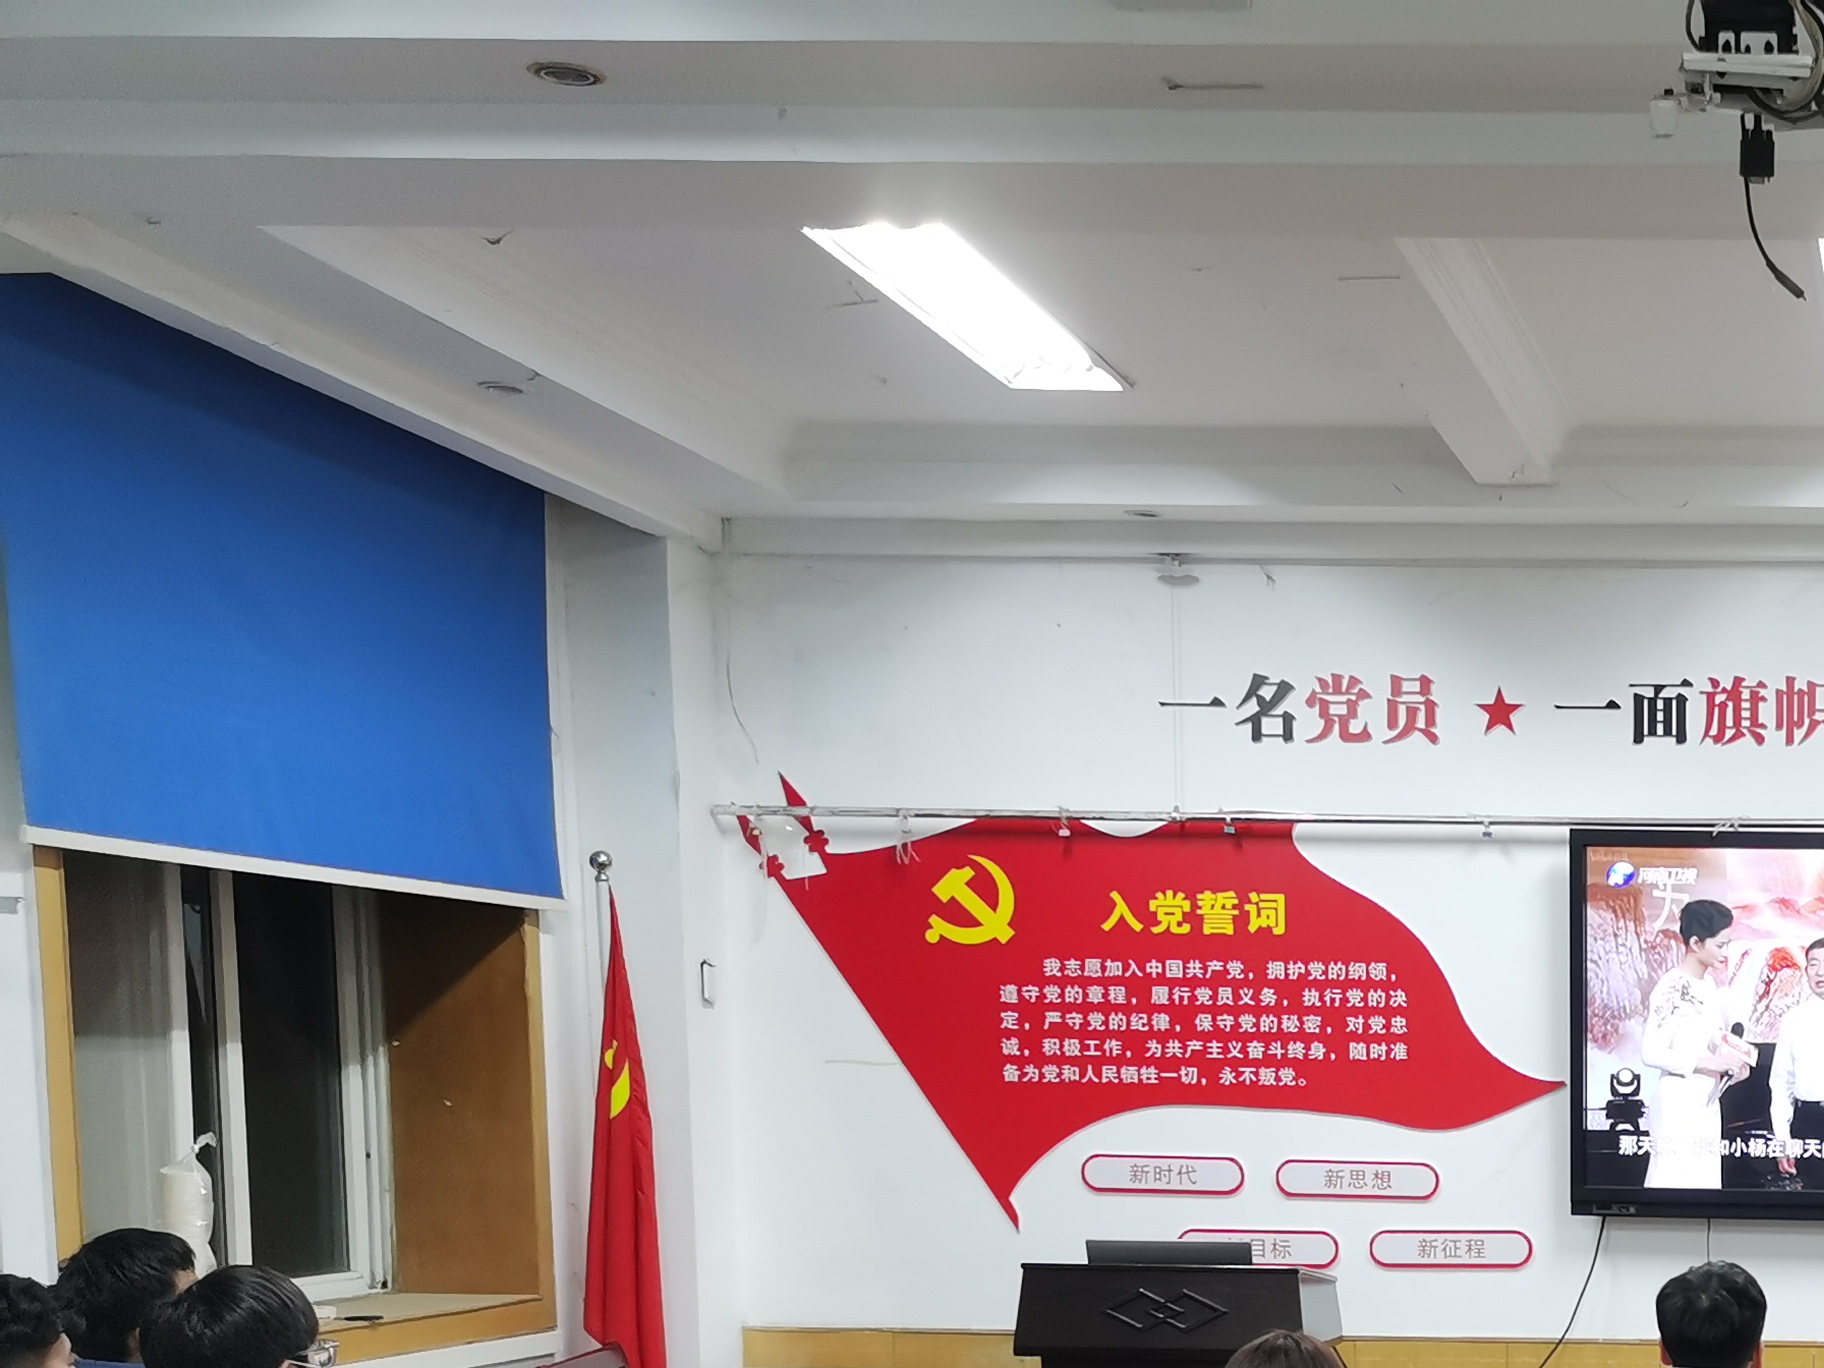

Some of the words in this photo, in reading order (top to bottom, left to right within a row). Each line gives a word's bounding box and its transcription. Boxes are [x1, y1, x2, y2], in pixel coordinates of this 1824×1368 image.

[1158, 673, 1440, 746] 一名党员
[1100, 890, 1286, 936] 入党誓词
[1043, 958, 1397, 982] 我志愿加入中国共产党，拥护党的纲领，
[1128, 1163, 1198, 1185] 新时代
[1323, 1168, 1393, 1191] 新思想
[1417, 1238, 1486, 1260] 新征程
